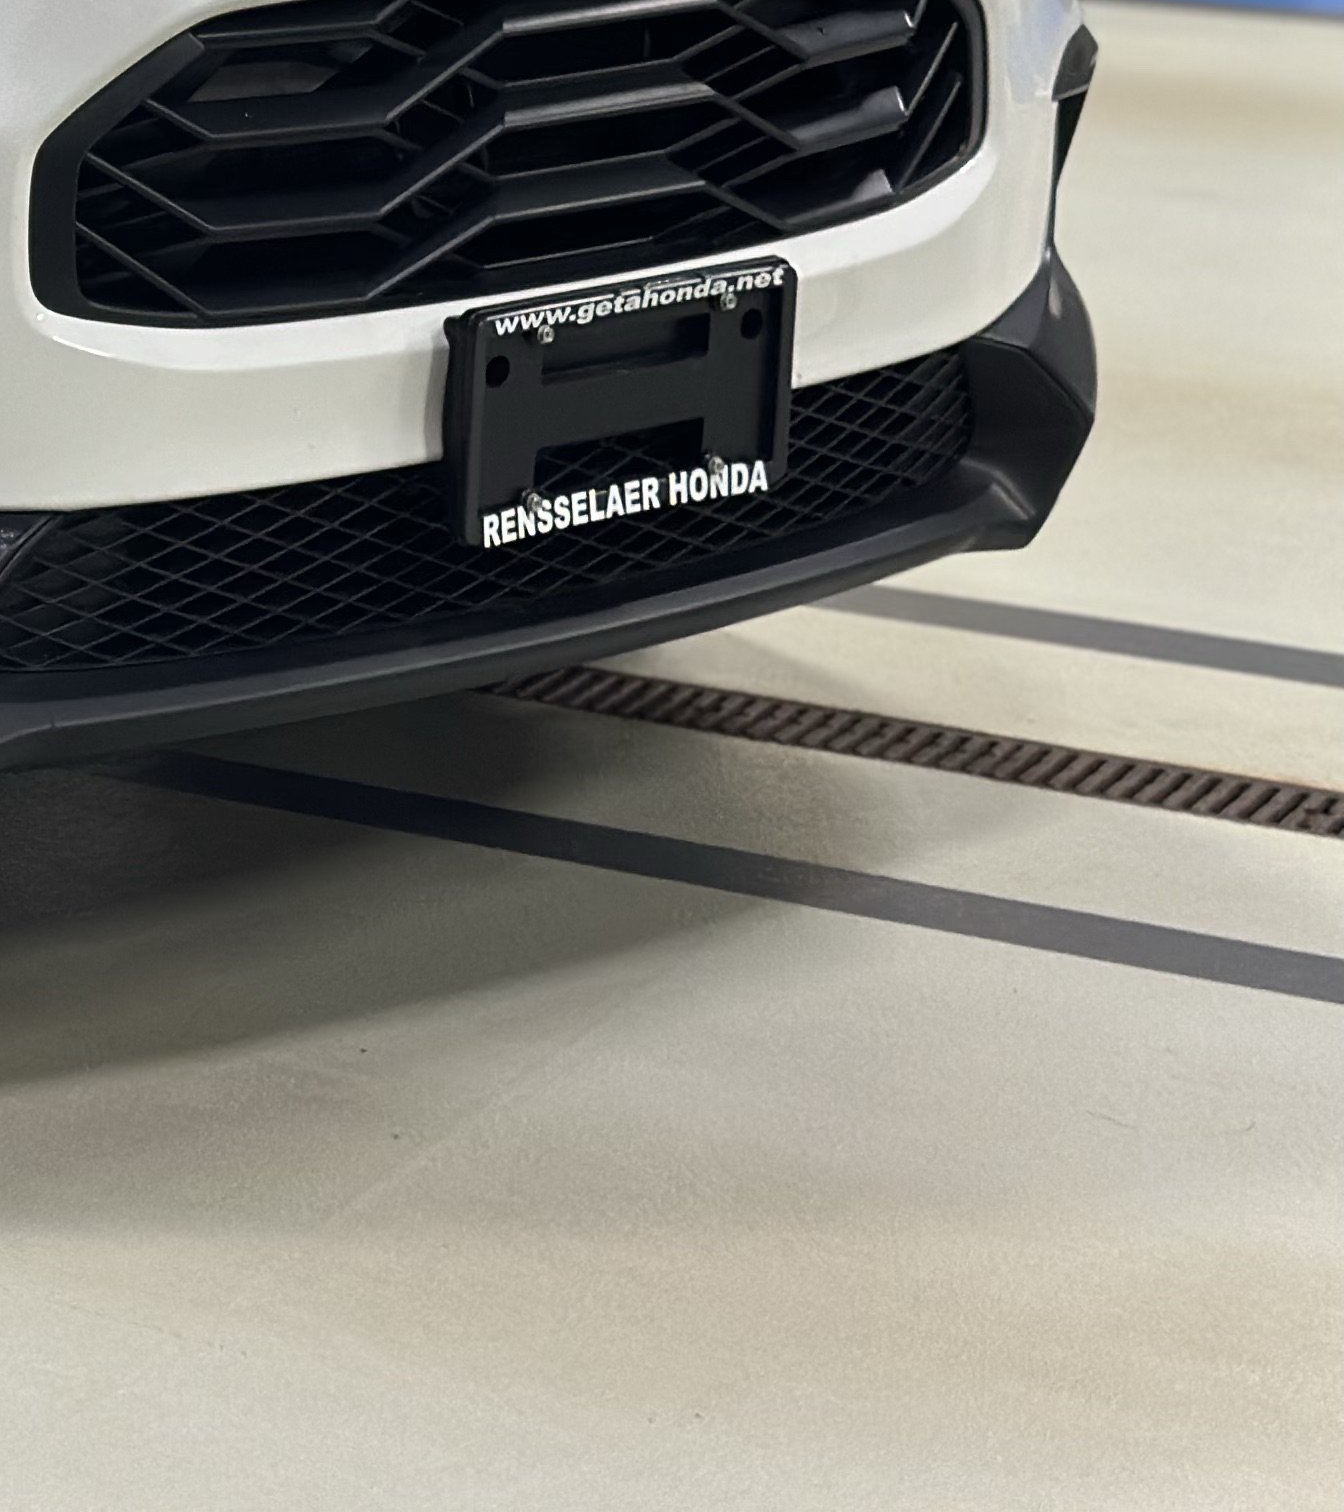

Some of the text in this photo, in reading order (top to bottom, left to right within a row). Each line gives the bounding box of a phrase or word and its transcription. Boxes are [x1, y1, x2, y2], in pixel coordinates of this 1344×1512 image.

[494, 266, 785, 336] www.getahonda.net
[482, 459, 769, 548] RENSSELAER HONDA
